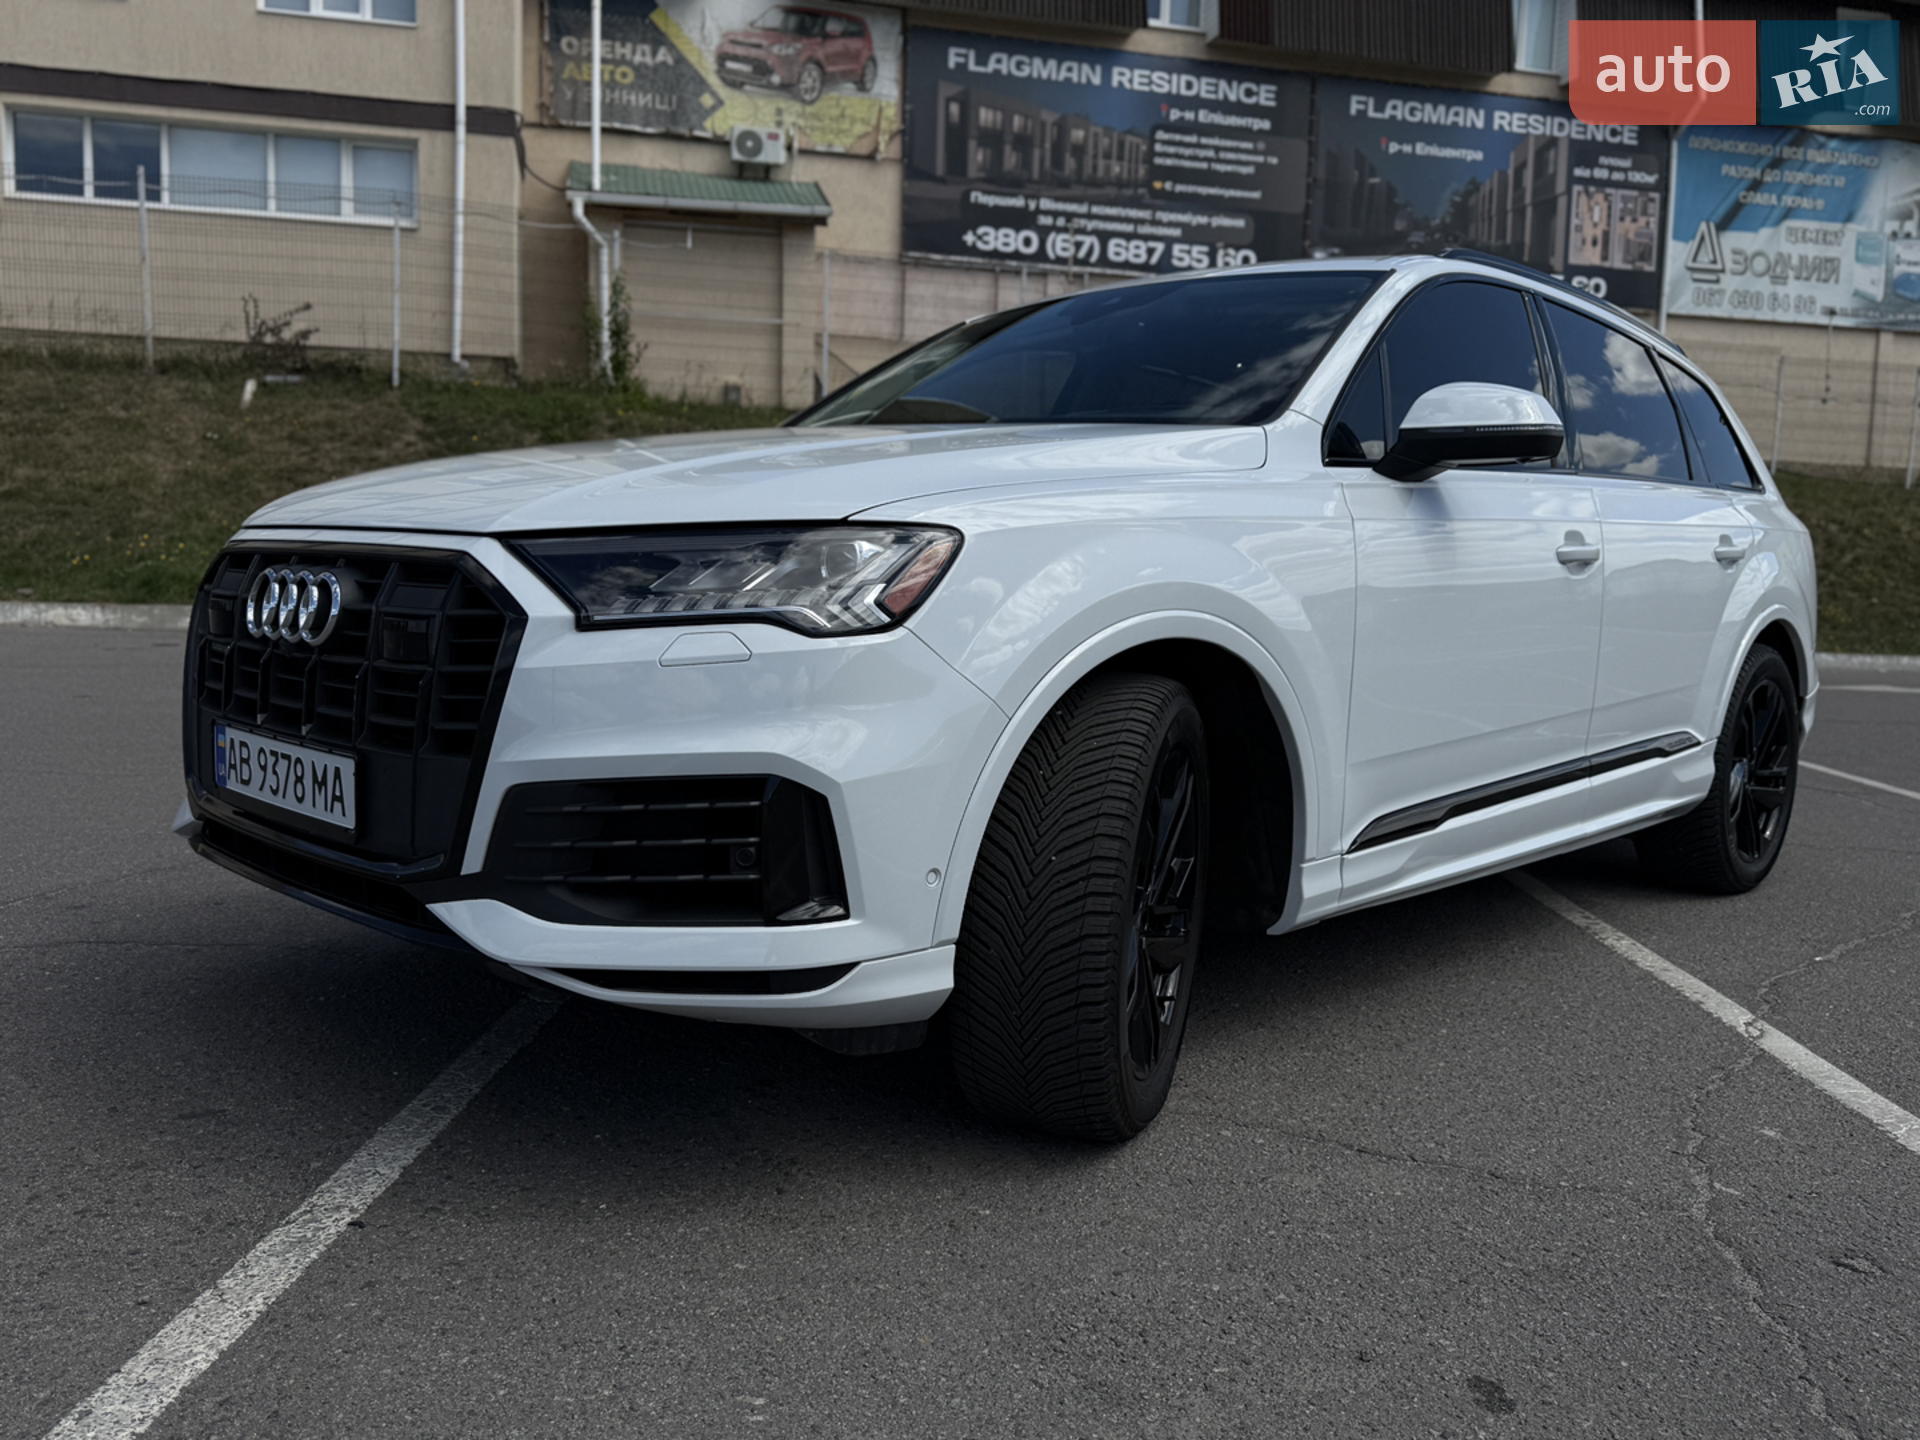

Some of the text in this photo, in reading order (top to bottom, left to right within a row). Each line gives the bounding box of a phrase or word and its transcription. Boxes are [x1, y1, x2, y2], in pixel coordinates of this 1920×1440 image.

[560, 36, 674, 66] ОРЕНДА
[947, 46, 1278, 107] FLAGMAN RESIDENCE
[1169, 108, 1272, 132] р-н Епіцентра
[1349, 94, 1640, 146] FLAGMAN RESIDENCE
[1388, 141, 1484, 162] р-н Епіцентра
[970, 190, 1026, 209] Перший
[1039, 197, 1089, 215] Вінниці
[1090, 202, 1153, 221] комплекс
[962, 226, 1258, 269] +380 (67) 687 55 60
[228, 737, 346, 817] AB 9378 MA
